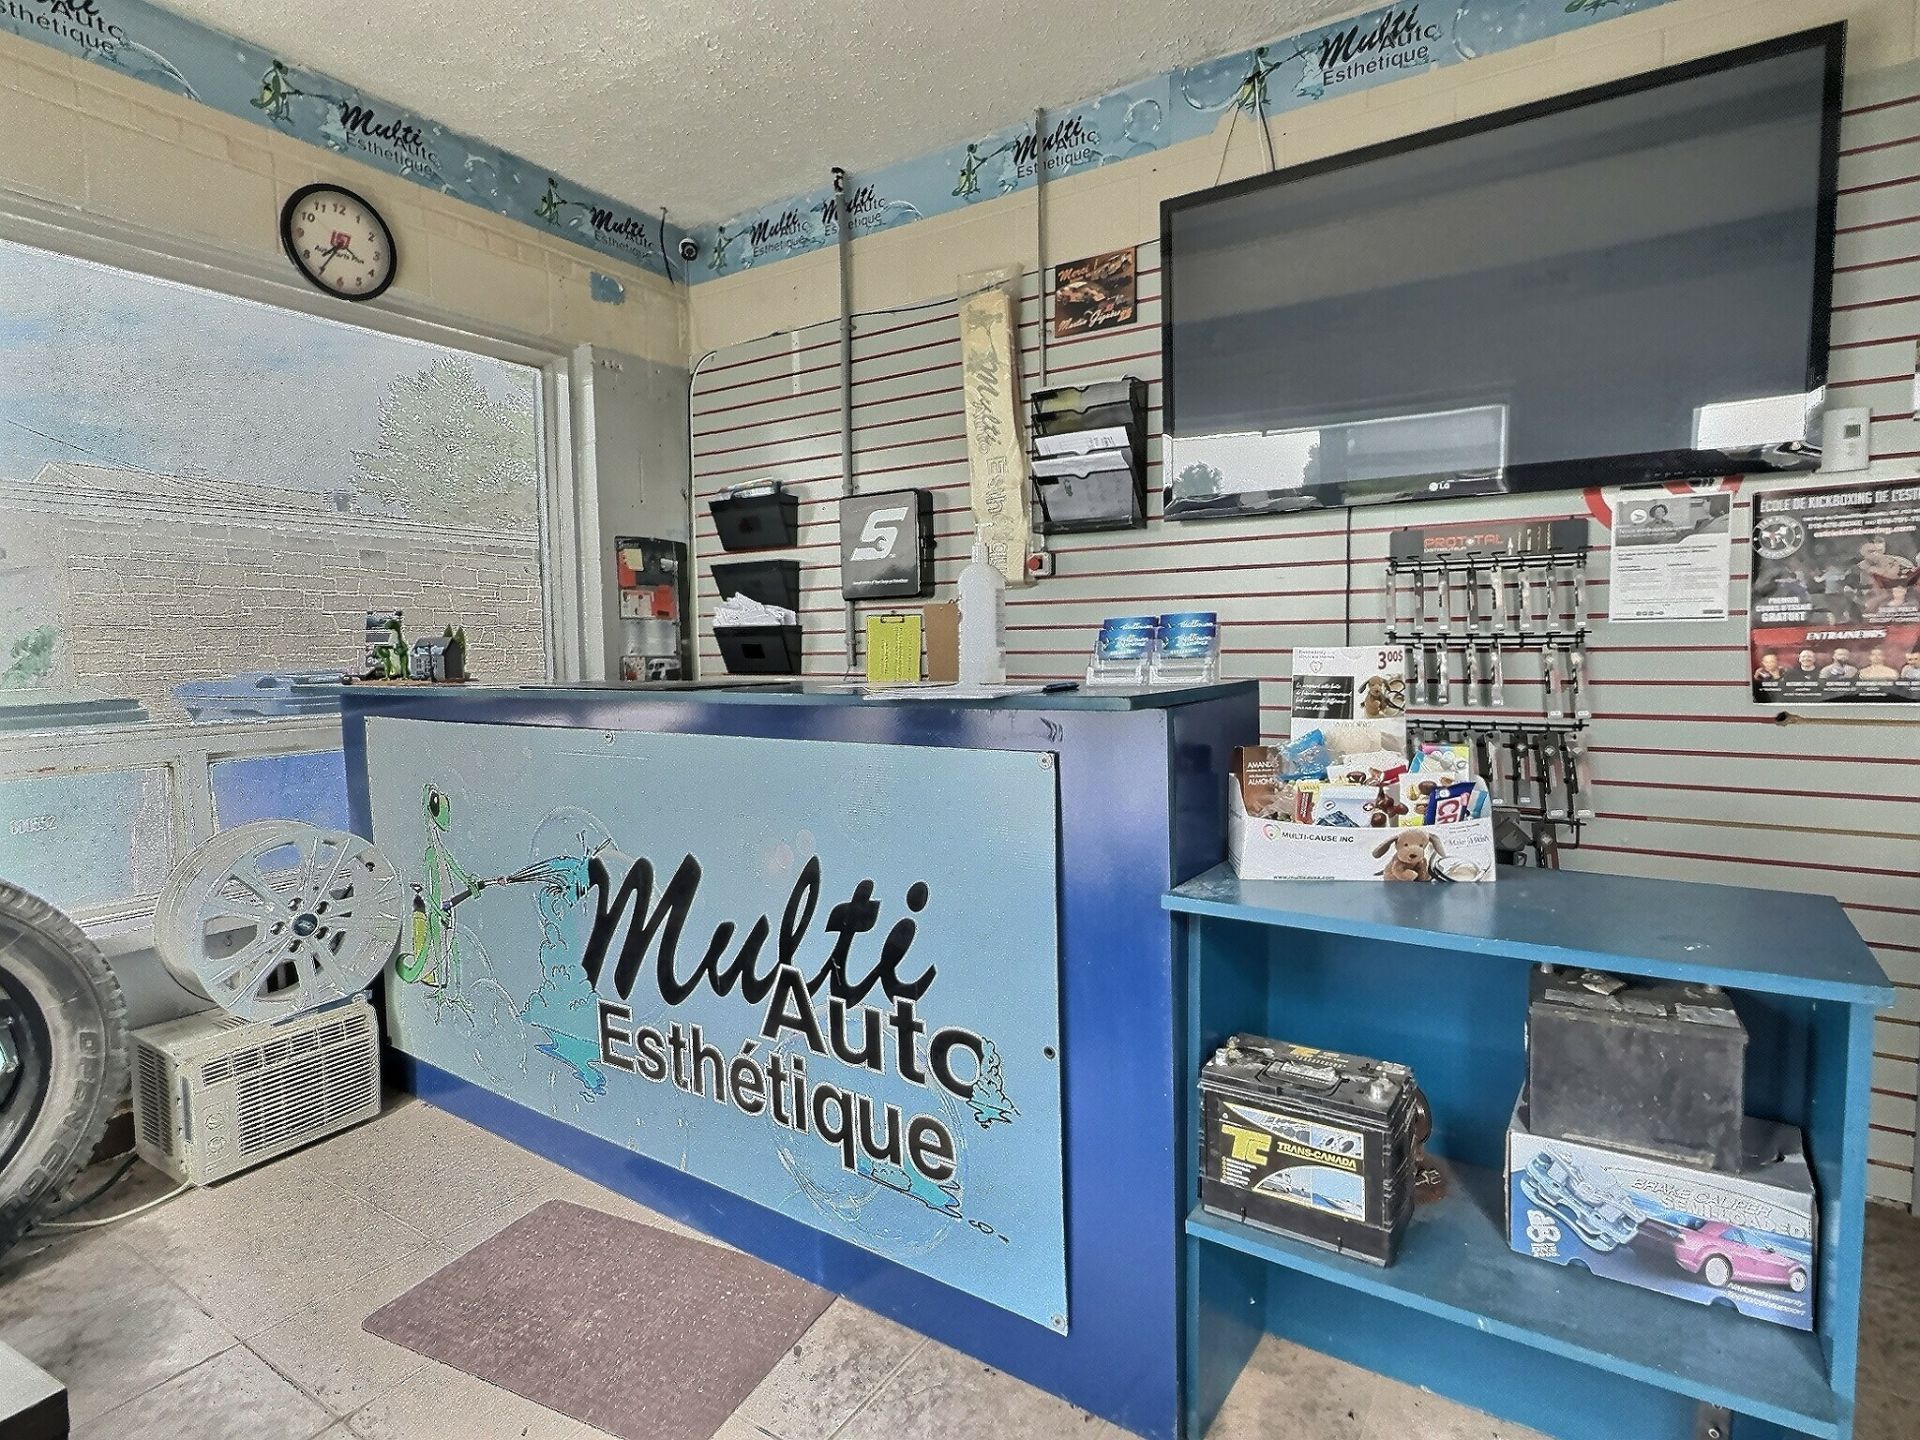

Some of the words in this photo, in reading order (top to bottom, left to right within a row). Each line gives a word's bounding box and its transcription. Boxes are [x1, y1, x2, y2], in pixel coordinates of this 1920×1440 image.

[1319, 4, 1418, 71] Multi
[1323, 45, 1429, 86] Esthétique
[340, 101, 422, 147] Multi
[302, 211, 315, 223] 10
[314, 200, 326, 213] 11
[333, 203, 346, 216] 12
[356, 215, 361, 224] 1
[590, 206, 645, 237] Multi
[368, 232, 376, 242] 2
[303, 249, 311, 259] 8
[368, 269, 375, 278] 4
[1282, 831, 1337, 842] MULTI-CAUSE
[582, 852, 938, 1005] Multi
[762, 963, 986, 1101] Auto
[596, 998, 957, 1185] Esthétique
[1277, 1141, 1357, 1168] TRANS-CANADA
[1631, 1178, 1691, 1201] BRAKE
[1694, 1193, 1772, 1217] CALIPER
